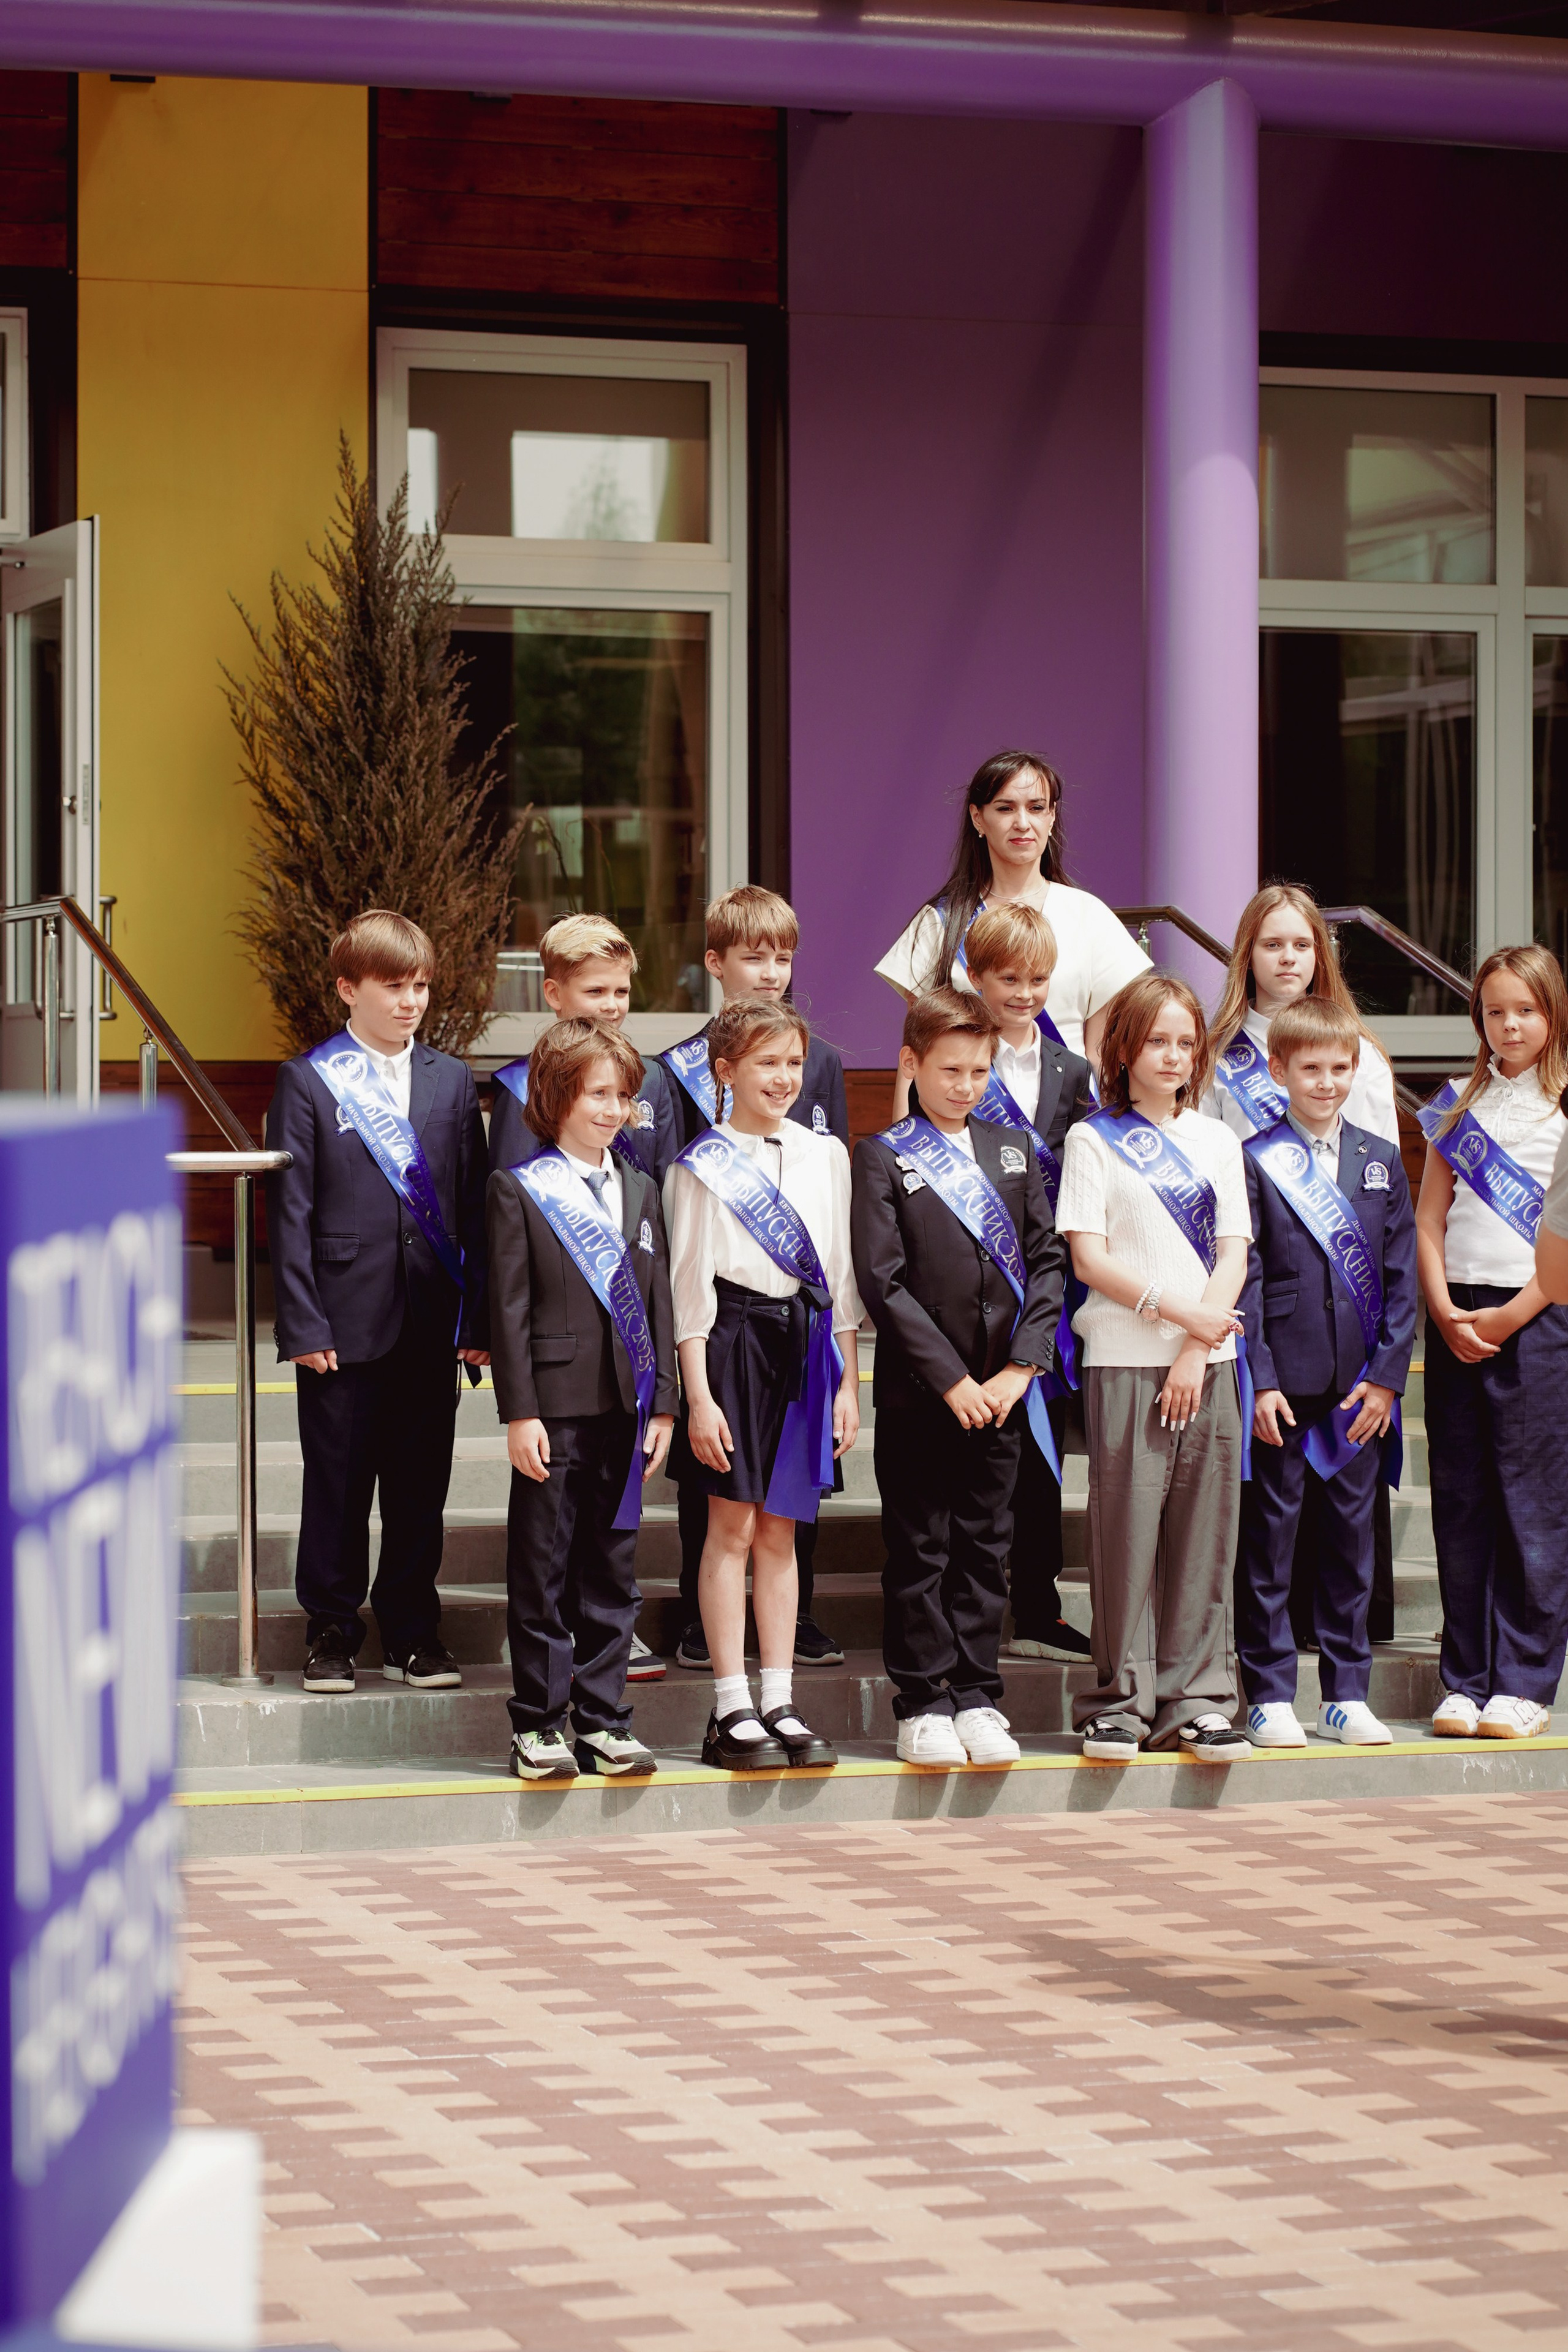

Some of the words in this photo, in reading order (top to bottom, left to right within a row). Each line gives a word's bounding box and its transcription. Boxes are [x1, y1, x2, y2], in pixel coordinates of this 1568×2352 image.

[1232, 1085, 1261, 1121] НАЧАЛЬНОЙ
[1240, 1071, 1286, 1119] ВЫПУ
[345, 1103, 377, 1145] НАЧАЛЬНОЙ
[372, 1144, 393, 1172] ШКОЛЫ
[1017, 1115, 1044, 1149] БЕШЕКОВ
[1139, 1133, 1155, 1150] VS
[1468, 1137, 1481, 1155] VS
[900, 1148, 938, 1183] НАЧАЛЬНОЙ
[935, 1180, 960, 1208] ШКОЛЫ
[908, 1134, 1009, 1255] ВЫПУСКНИК
[1370, 1166, 1382, 1175] VS
[778, 1199, 809, 1242] ЕВТУШЕНКО
[1149, 1178, 1181, 1215] АЧАЛЬНОЙ
[1176, 1213, 1197, 1242] ШКОЛЫ
[1197, 1177, 1218, 1216] ЕМЕЛЬЯНО
[1483, 1163, 1544, 1239] ВЫПУСК
[547, 1210, 581, 1254] НАЧАЛЬНОЙ
[576, 1253, 598, 1283] ШКОЛЫ
[728, 1170, 813, 1276] ВЫПУСКНИ
[752, 1227, 776, 1254] ШКОЛЫ
[1289, 1195, 1322, 1235] НАЧАЛЬНОЙ
[1318, 1233, 1340, 1261] ШКОЛЫ
[1302, 1177, 1378, 1313] ВЫПУСКНИК
[1351, 1219, 1368, 1246] ДЫБОВ
[1509, 1215, 1533, 1238] ШКОЛЫ
[608, 1227, 631, 1266] УДОВКИН
[627, 1265, 641, 1302] МАКСИМ
[631, 1323, 655, 1372] 2025
